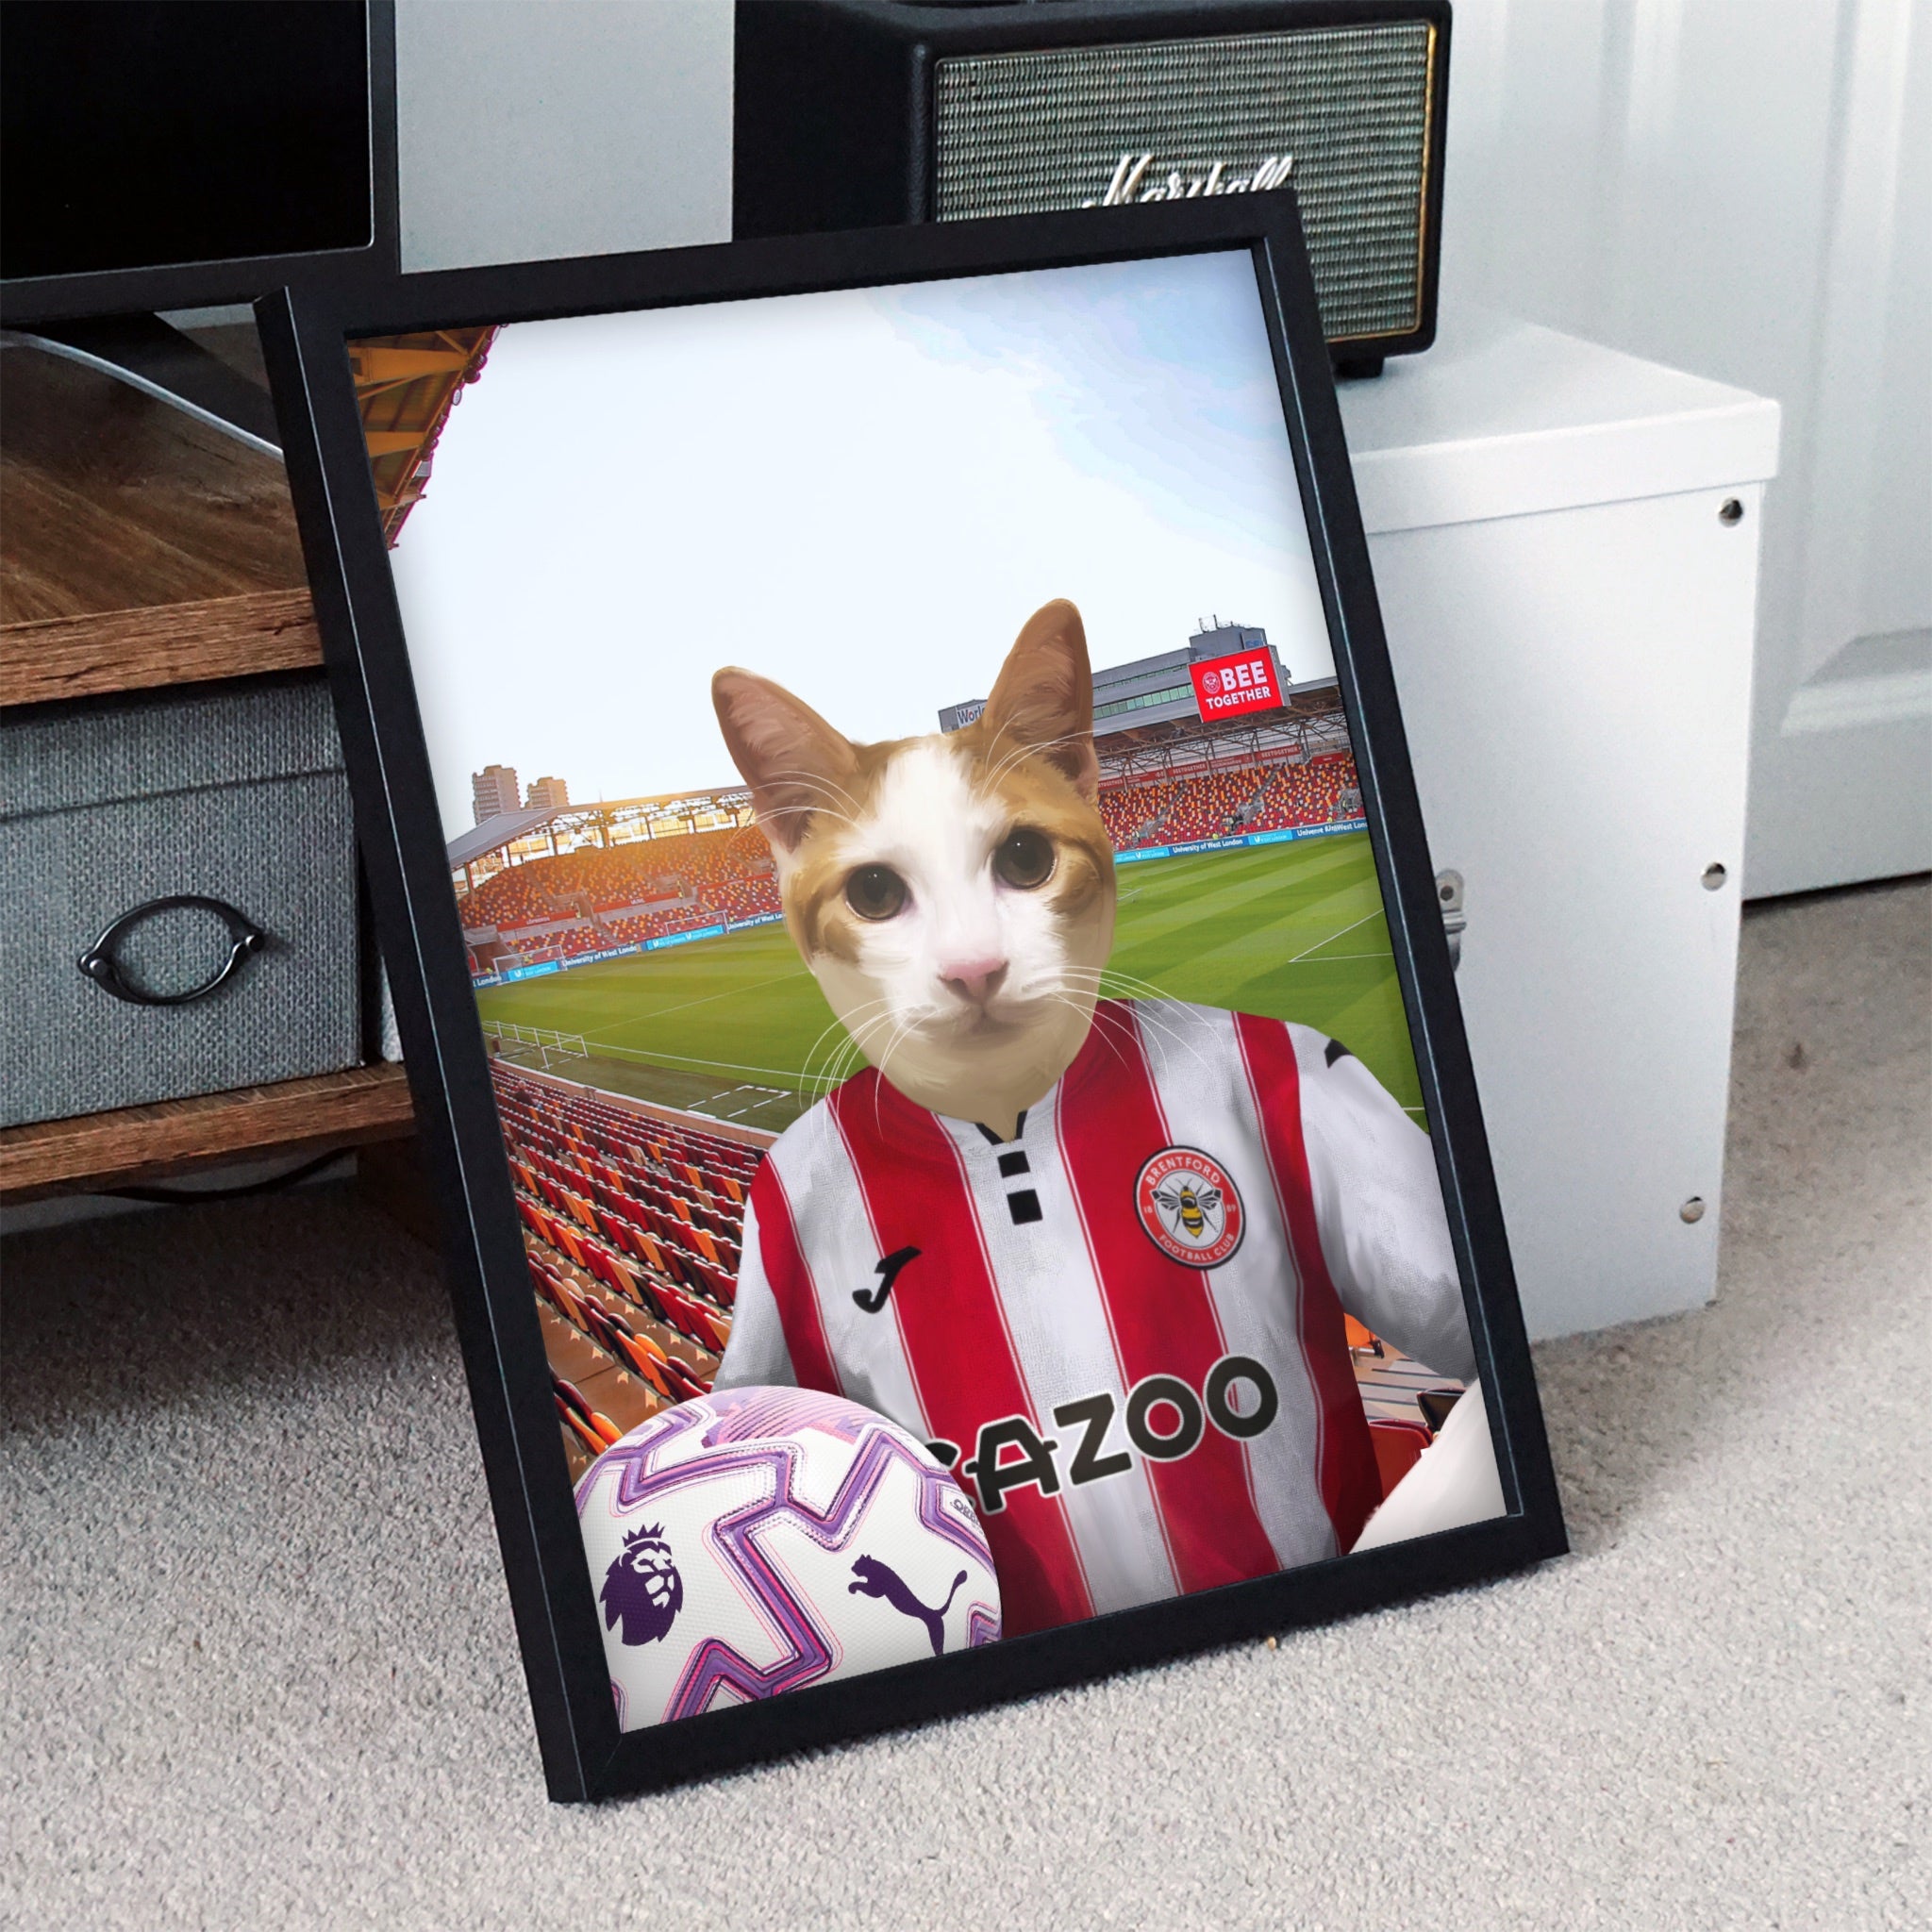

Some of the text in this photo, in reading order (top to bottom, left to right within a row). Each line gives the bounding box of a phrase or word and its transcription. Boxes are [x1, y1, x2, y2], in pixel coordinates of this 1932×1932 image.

[1219, 660, 1268, 691] BEE
[1205, 686, 1272, 709] TOGETHER
[1172, 843, 1200, 854] University
[1200, 841, 1208, 850] of
[1208, 841, 1222, 850] West
[1222, 838, 1243, 847] London
[1144, 1156, 1221, 1186] BRENTFORD
[1159, 1233, 1235, 1261] FOOTBALL CLUB
